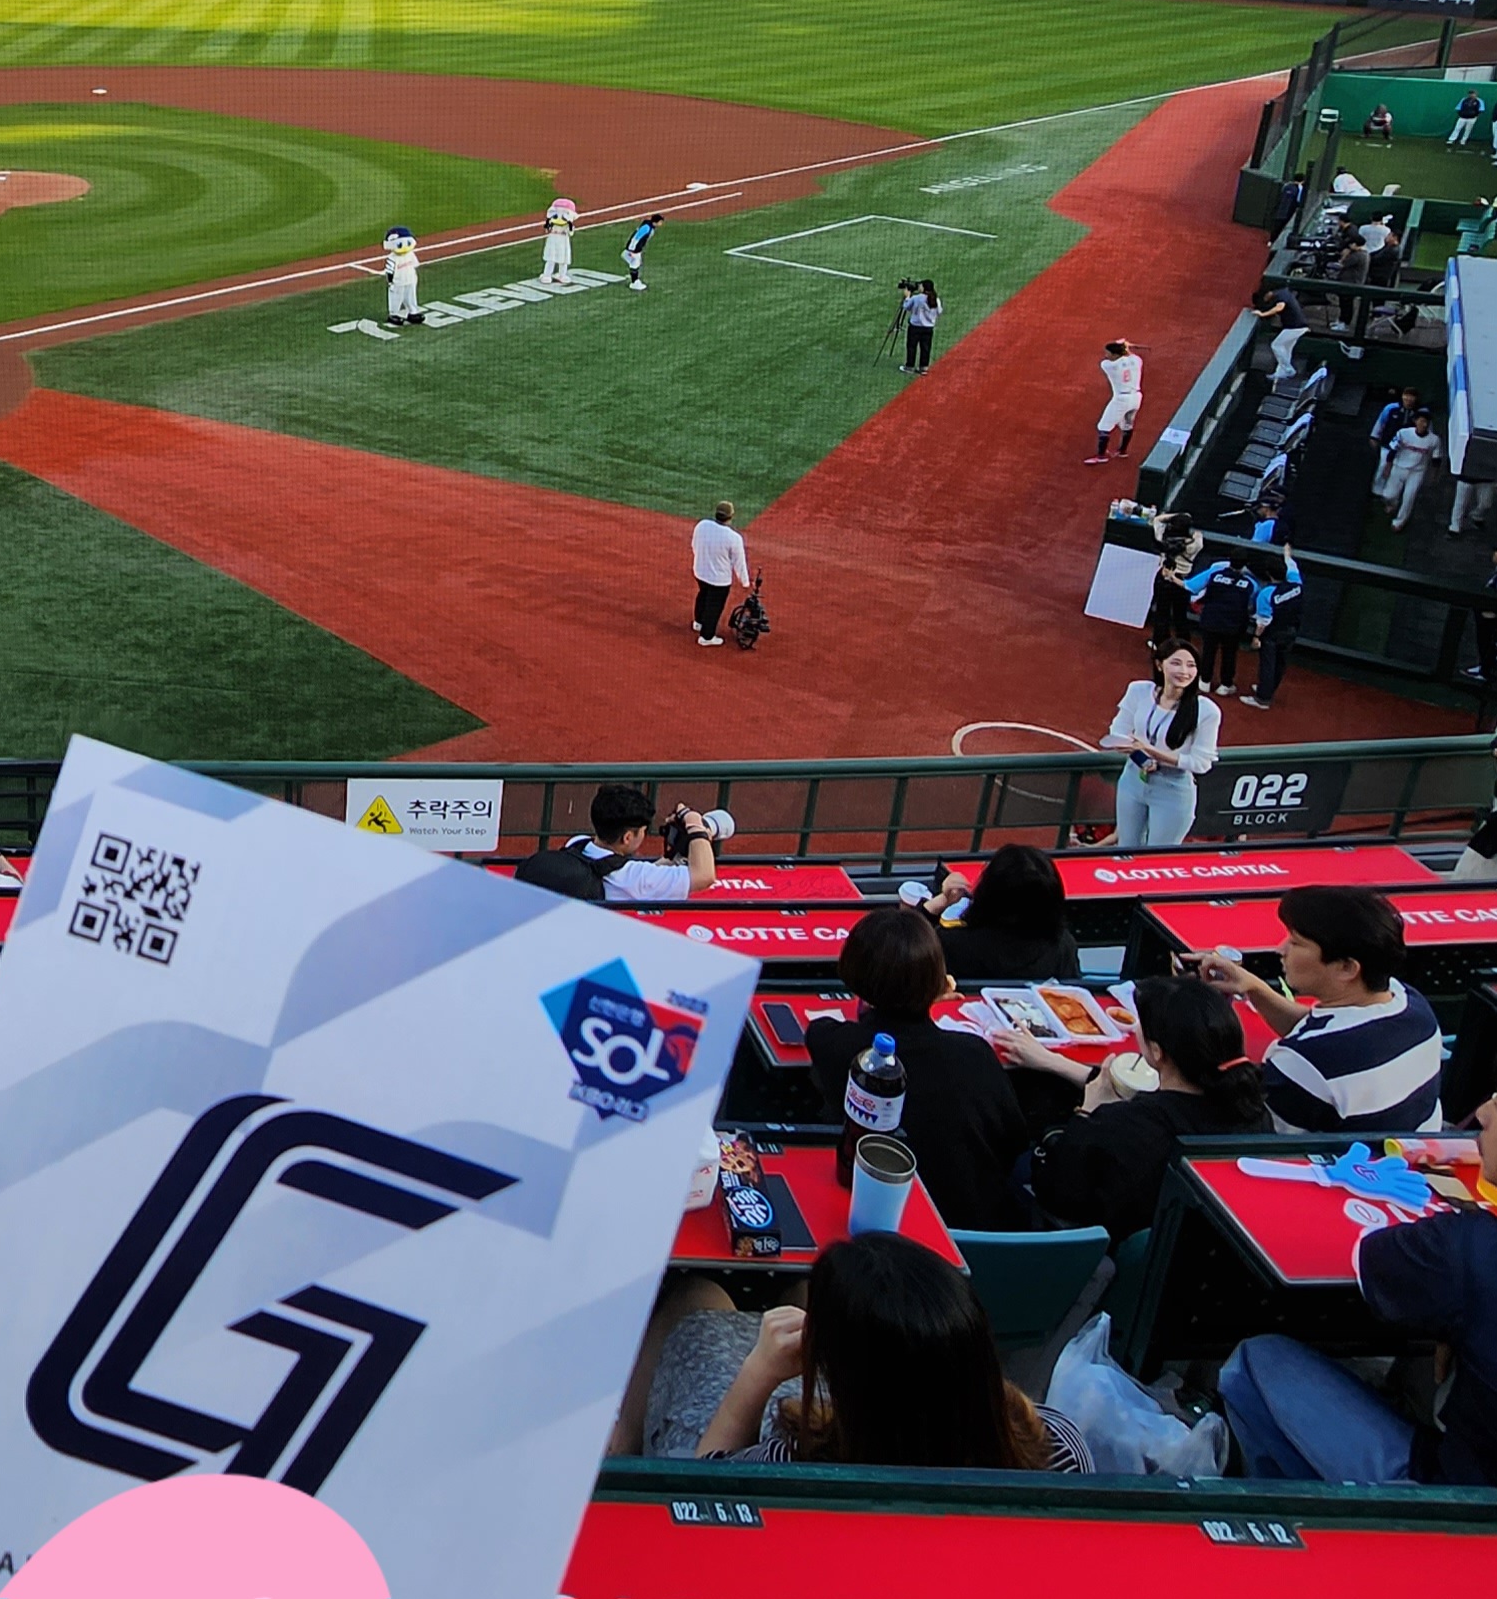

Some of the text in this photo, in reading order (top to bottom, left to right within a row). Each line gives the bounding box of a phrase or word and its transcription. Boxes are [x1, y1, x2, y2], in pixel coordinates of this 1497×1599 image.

[1231, 773, 1308, 808] 022
[406, 799, 493, 821] 추락주의
[1233, 812, 1289, 825] BLOCK
[409, 826, 487, 837] Watch Your Step
[1118, 863, 1289, 881] LOTTE CAPITAL
[709, 878, 773, 890] PITAL
[1400, 910, 1456, 925] TTE
[716, 926, 809, 941] LOTTE
[672, 1502, 700, 1521] 022
